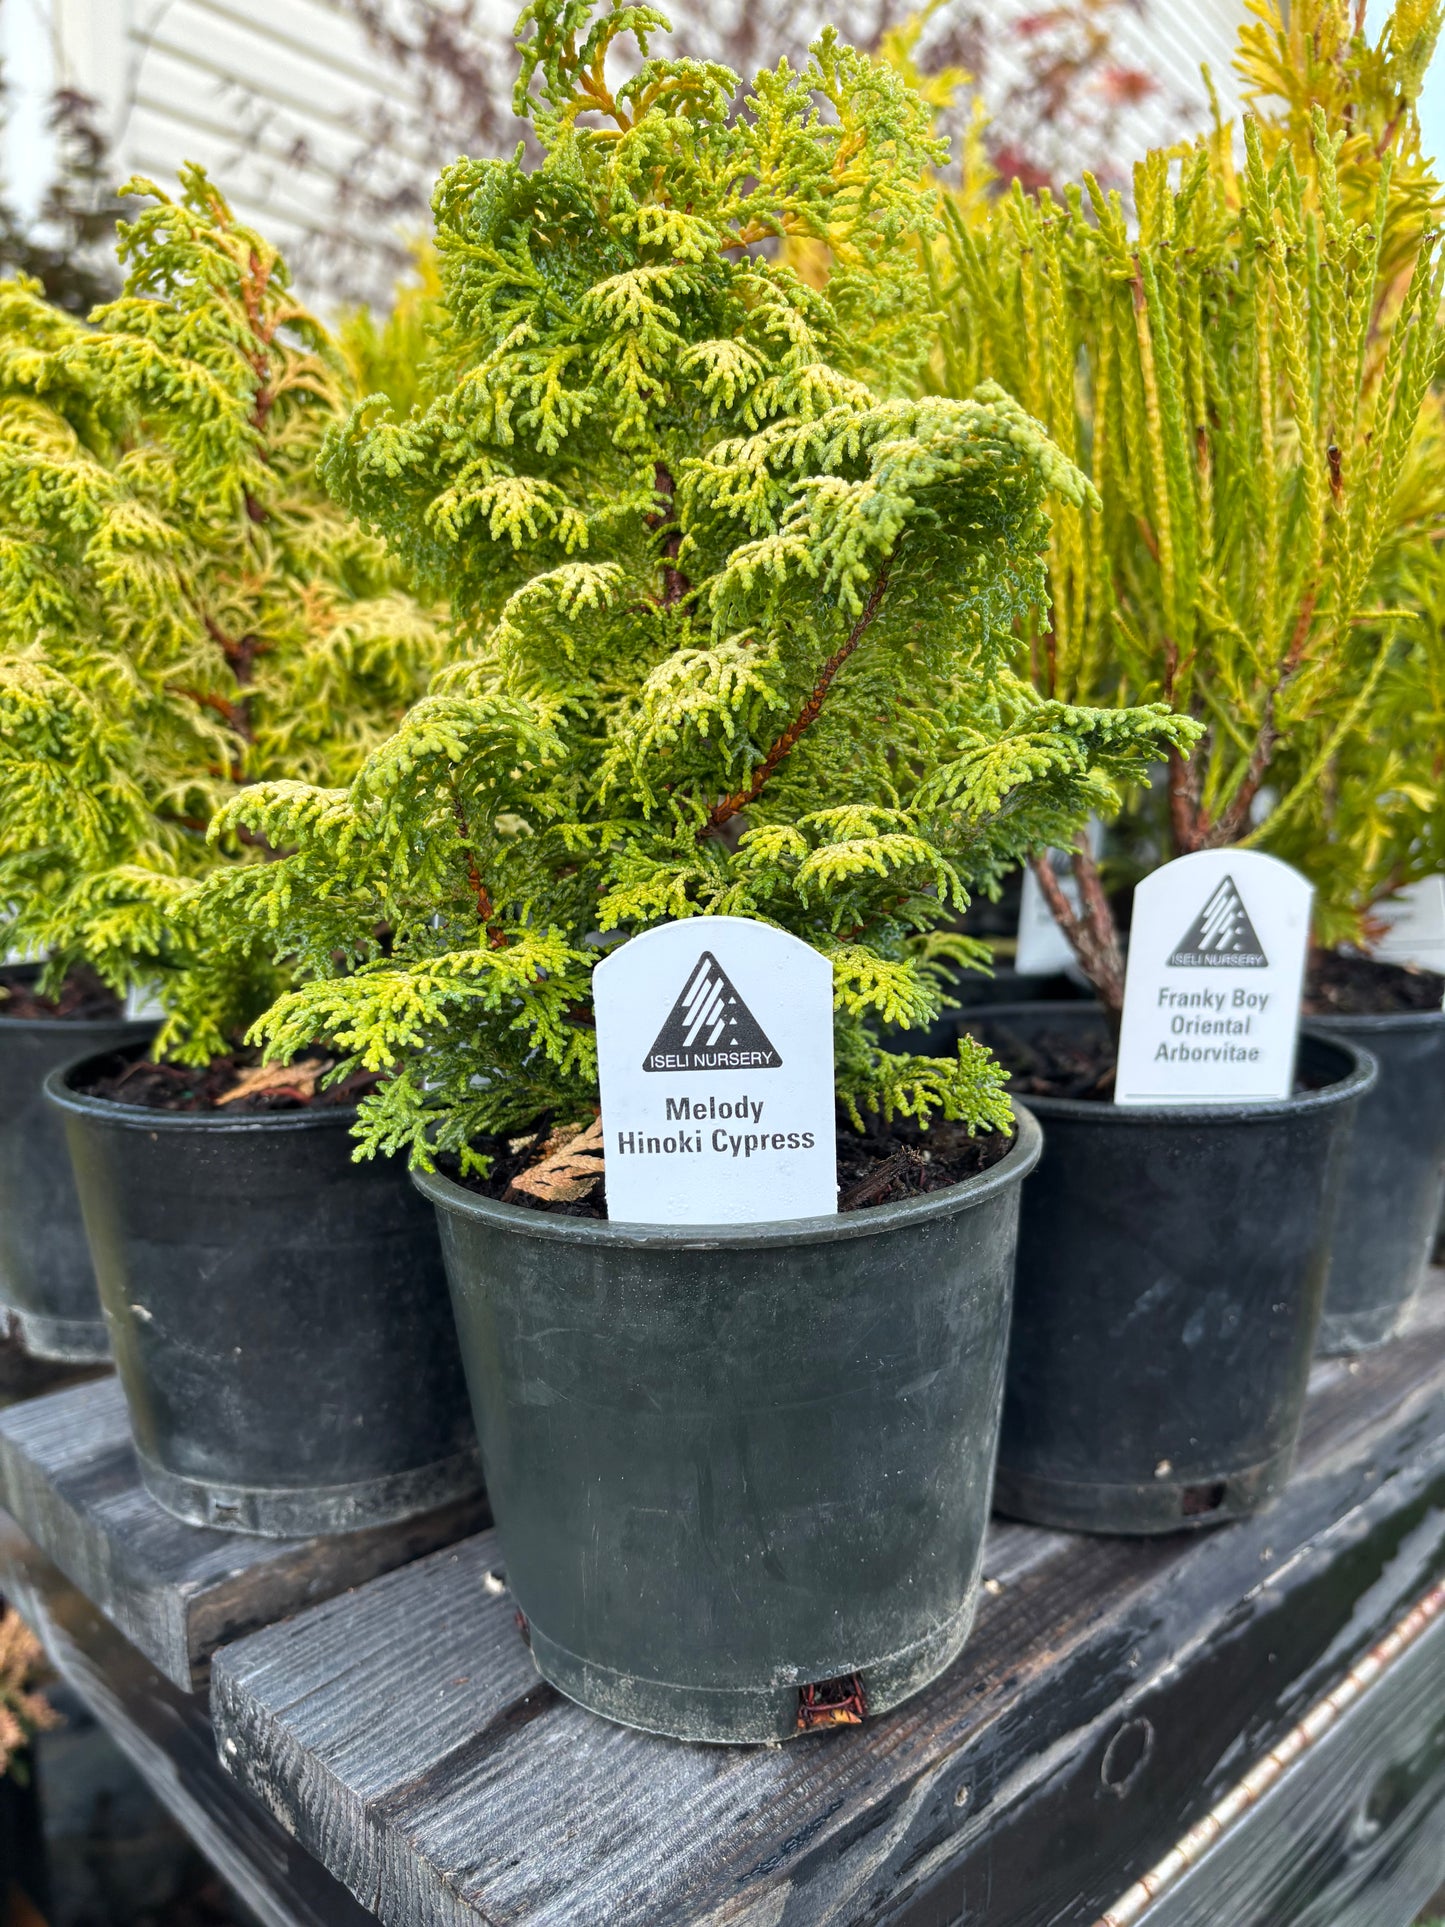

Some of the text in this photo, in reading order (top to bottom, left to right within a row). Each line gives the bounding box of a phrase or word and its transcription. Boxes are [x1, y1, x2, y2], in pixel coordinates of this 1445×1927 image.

[1171, 953, 1265, 966] ISELI NURSERY
[1157, 987, 1270, 1011] Franky Boy
[1170, 1015, 1251, 1035] Oriental
[650, 1051, 774, 1069] ISELI NURSERY
[1154, 1042, 1260, 1062] Arborvitae
[665, 1095, 764, 1124] Melody
[617, 1128, 816, 1158] Hinoki Cypress
